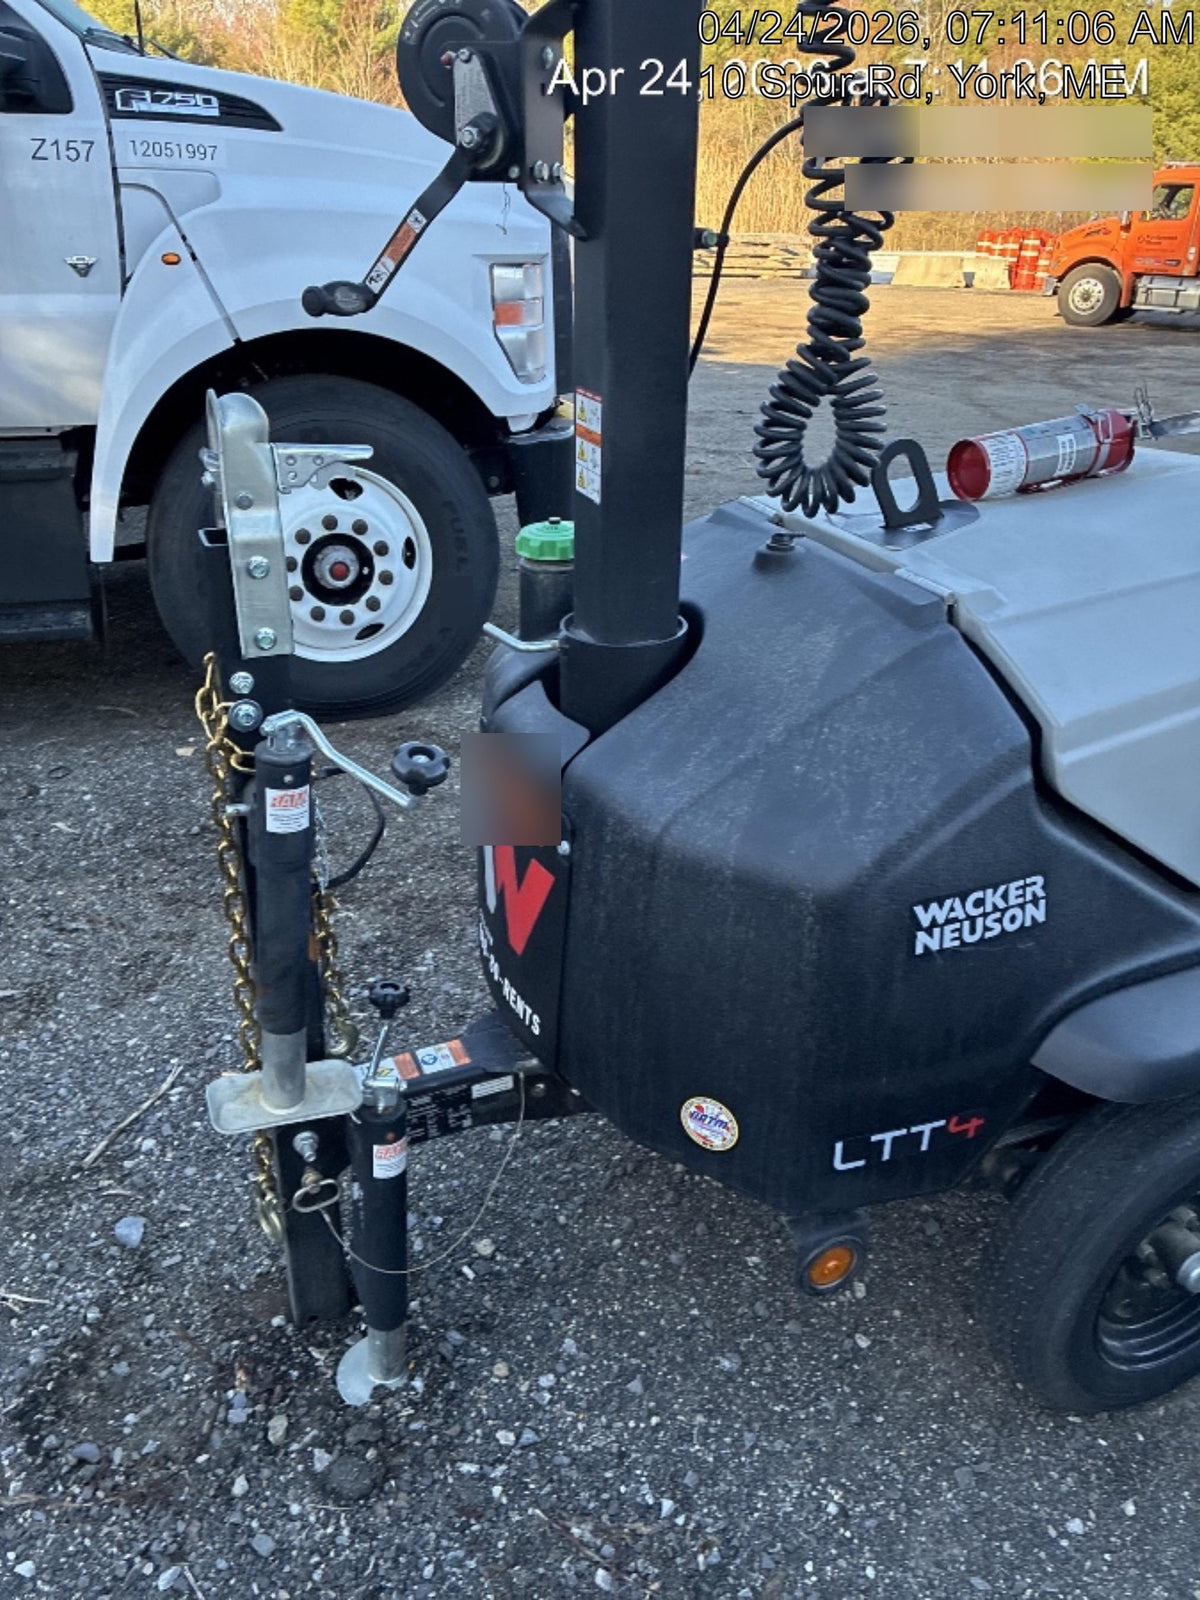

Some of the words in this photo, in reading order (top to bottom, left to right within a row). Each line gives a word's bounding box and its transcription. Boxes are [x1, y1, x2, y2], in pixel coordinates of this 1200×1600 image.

[30, 138, 95, 162] Z157
[129, 139, 218, 161] 12051997
[913, 875, 1047, 928] WACKER
[914, 899, 1047, 955] NEUSON
